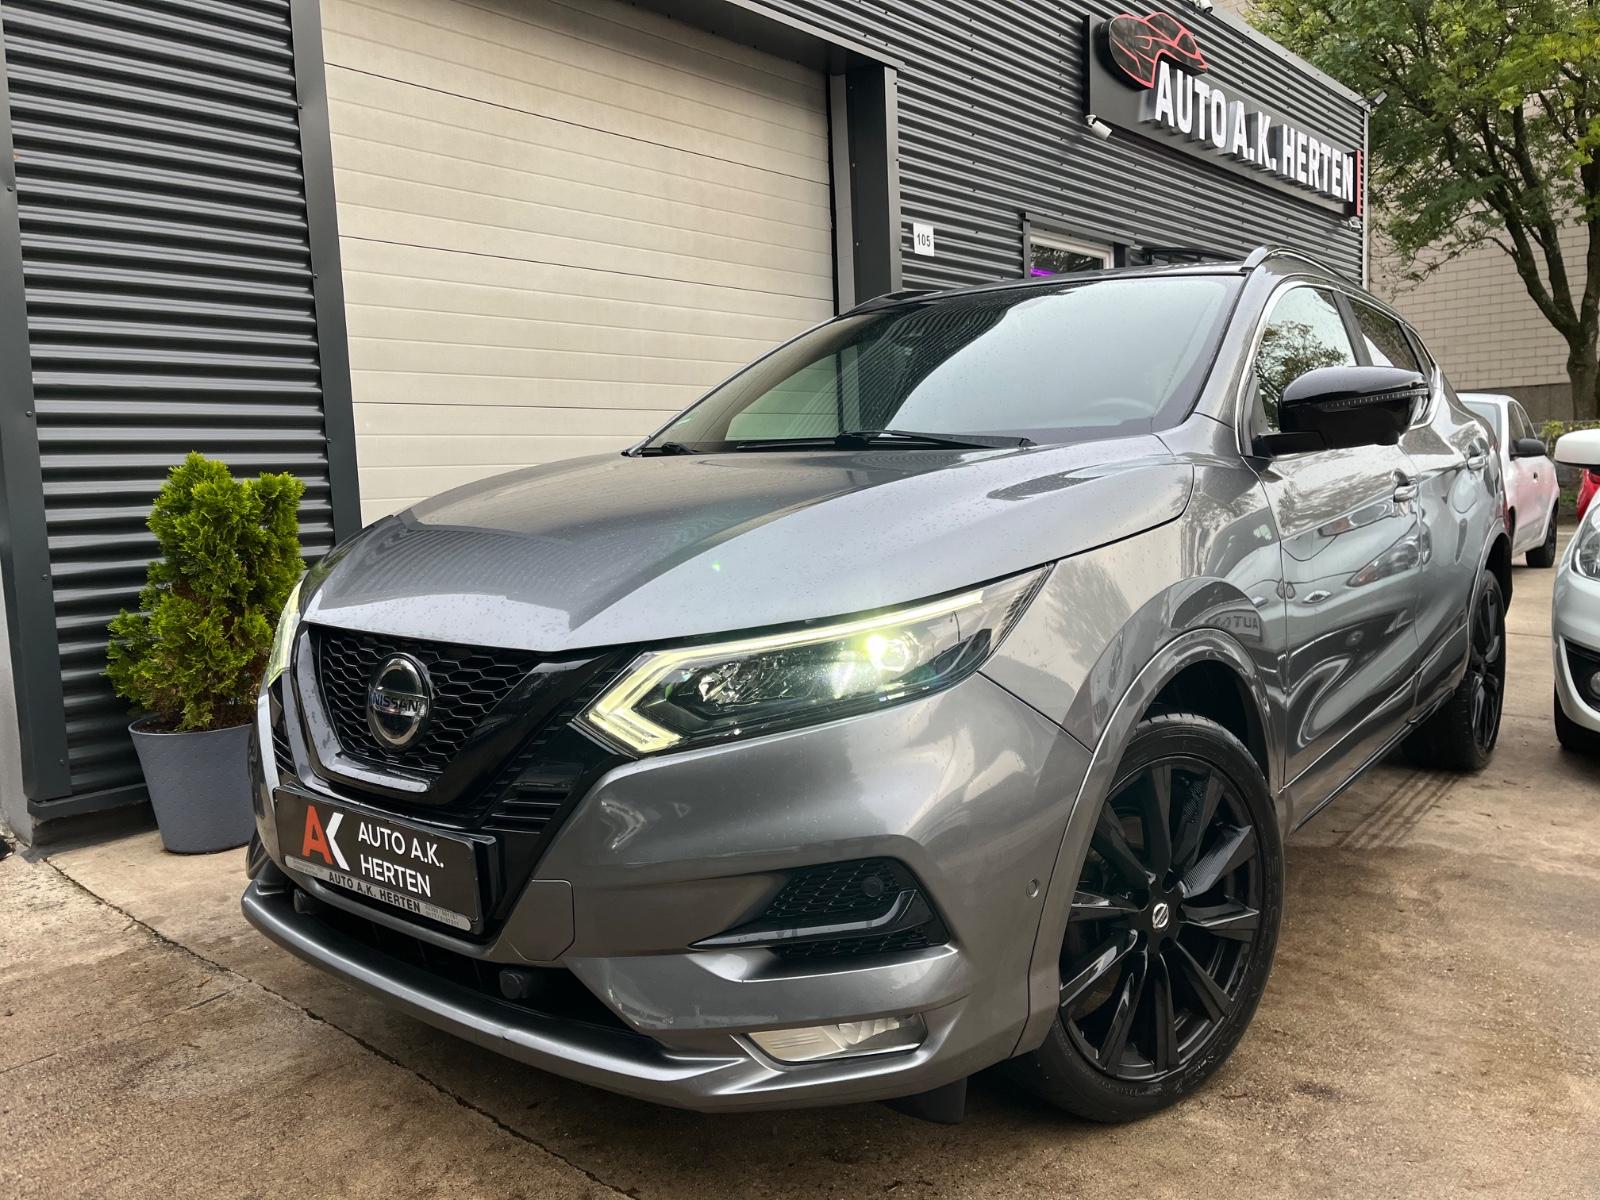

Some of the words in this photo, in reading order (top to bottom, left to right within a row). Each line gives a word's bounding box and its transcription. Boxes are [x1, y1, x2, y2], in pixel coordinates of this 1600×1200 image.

[1155, 61, 1227, 148] AUTO
[1232, 100, 1277, 172] A.K.
[1282, 124, 1354, 202] HERTEN
[917, 233, 931, 247] 105
[373, 692, 419, 711] NISSAN
[302, 805, 350, 871] AK
[357, 821, 406, 856] AUTO
[410, 837, 445, 869] A.K.
[328, 871, 354, 889] AUTO
[356, 881, 377, 898] A.K.
[379, 889, 421, 914] HERTEN
[359, 853, 433, 898] HERTEN
